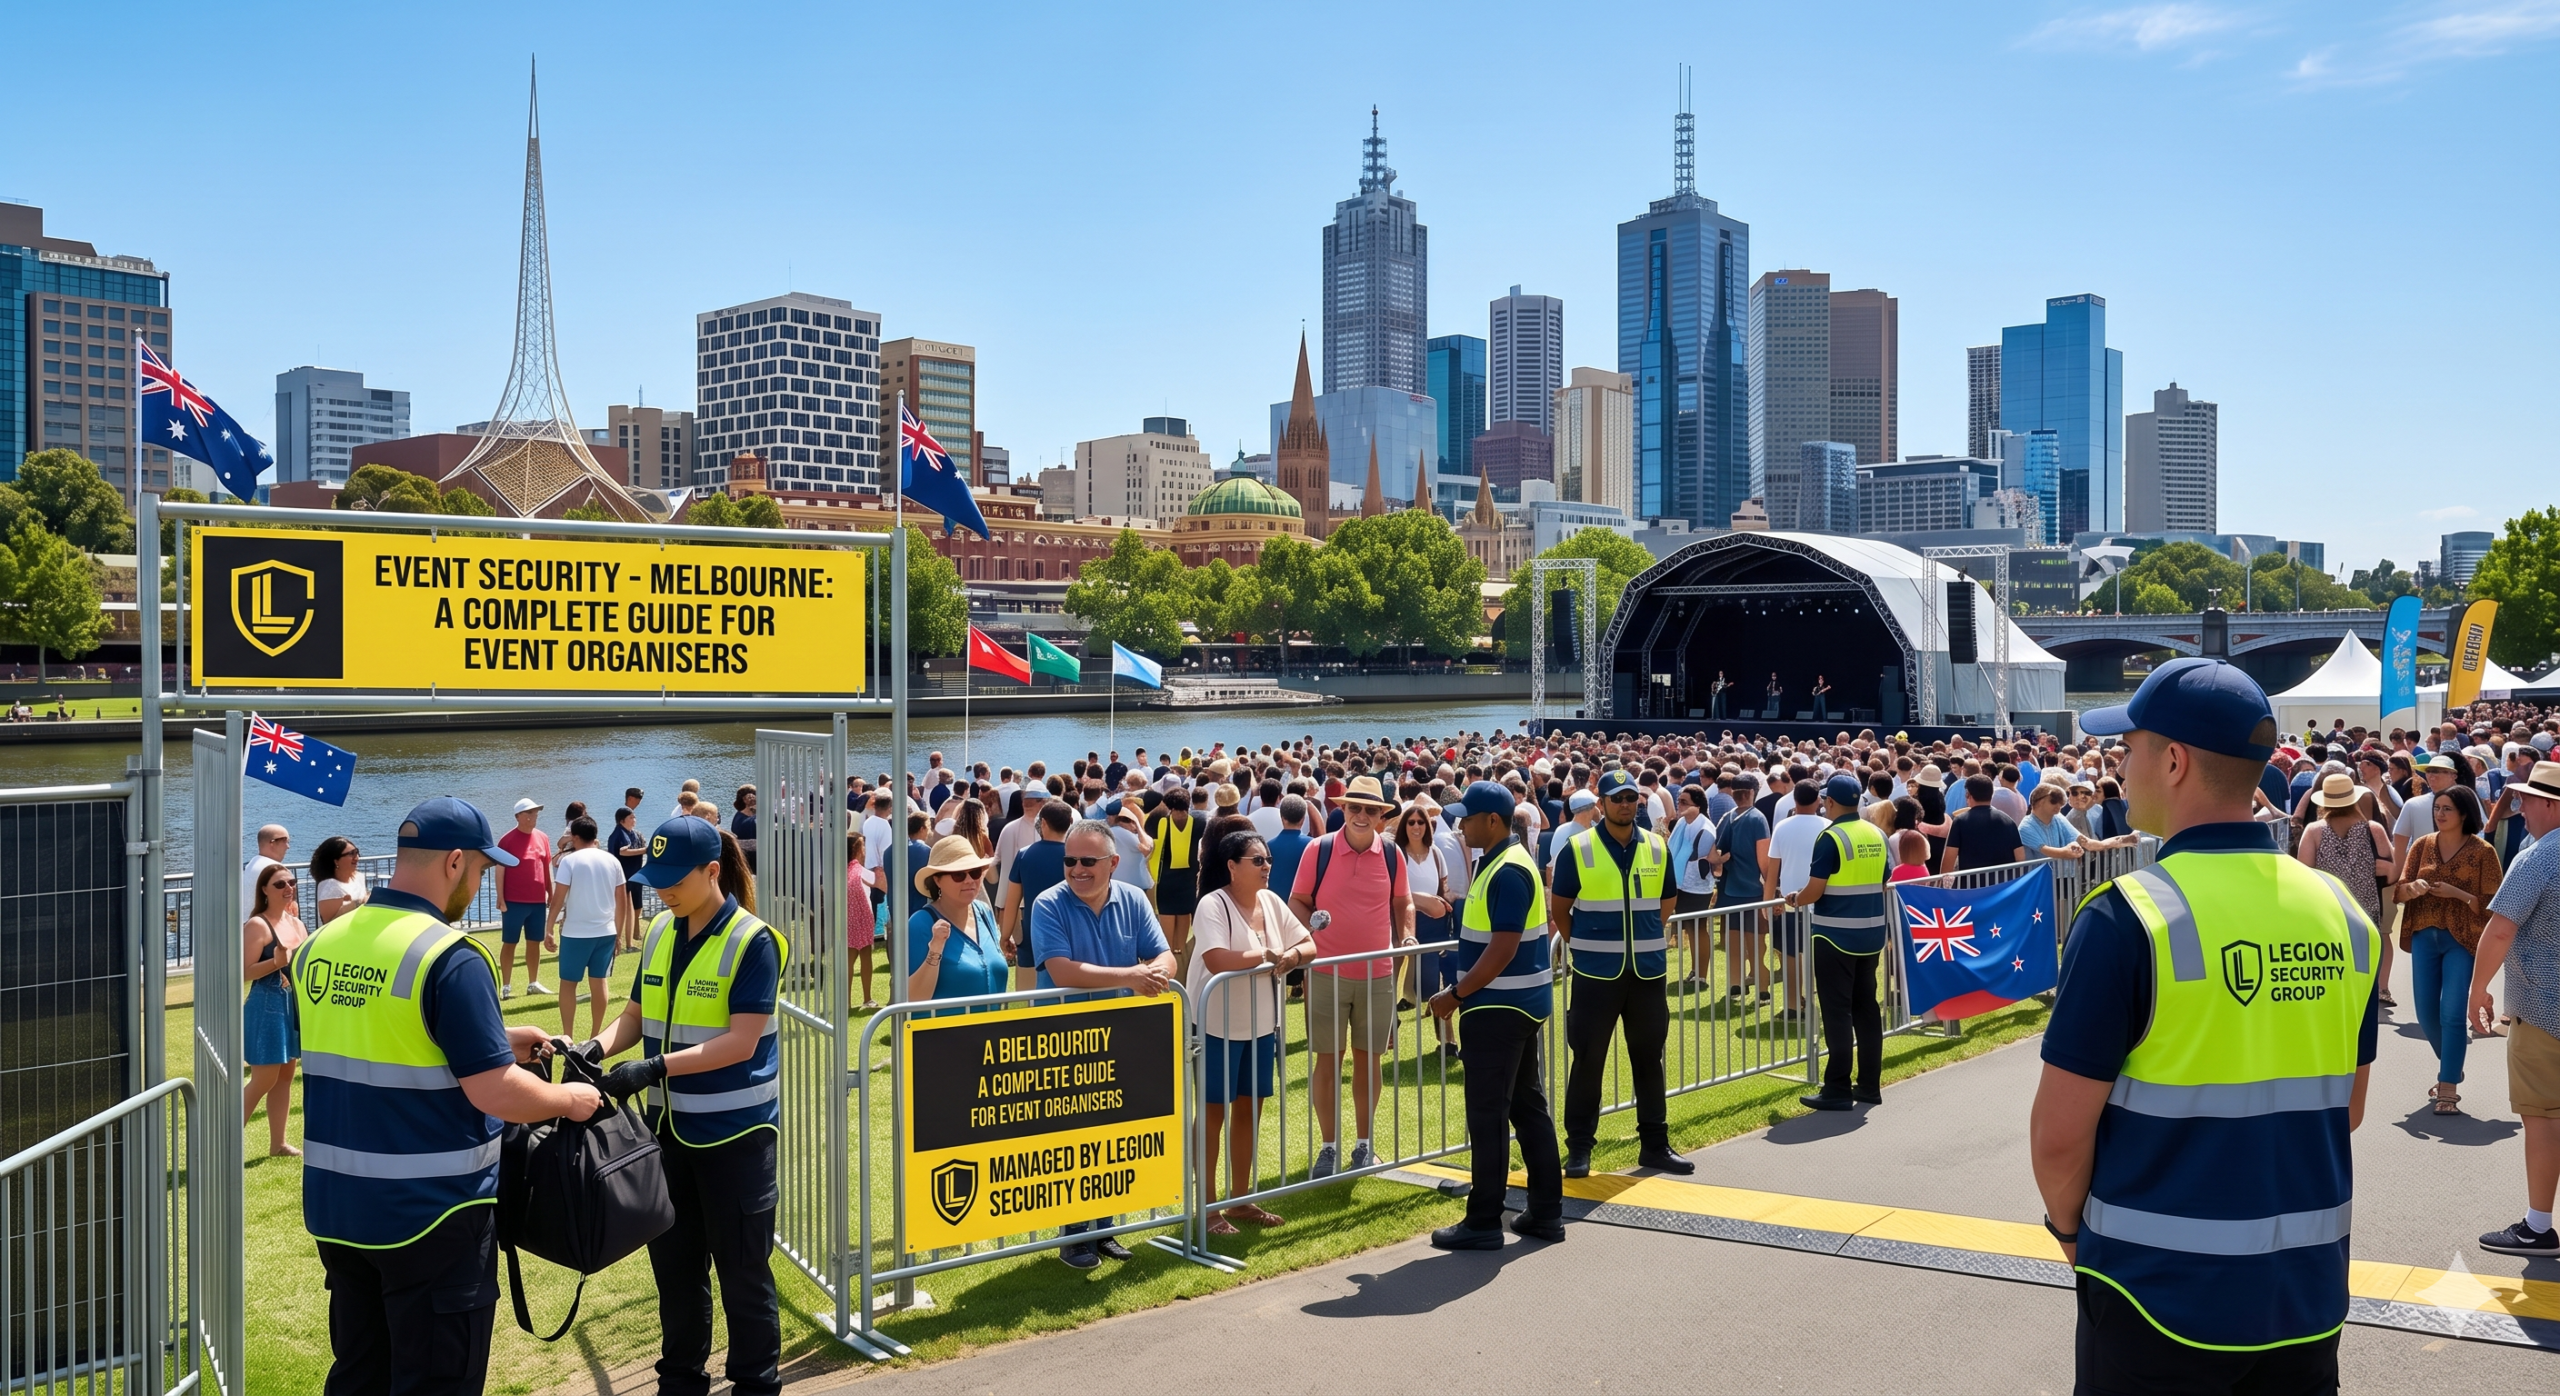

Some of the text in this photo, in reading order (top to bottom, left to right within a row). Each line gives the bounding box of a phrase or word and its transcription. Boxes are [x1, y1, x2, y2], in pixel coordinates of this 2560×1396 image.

[374, 555, 470, 590] EVENT
[478, 558, 621, 593] SECURITY
[650, 563, 834, 599] MELBOURNE:
[434, 597, 776, 636] A COMPLETE GUIDE FOR
[464, 637, 749, 675] EVENT ORGANISERS
[2268, 942, 2345, 963] LEGION
[332, 979, 383, 998] SECURITY
[333, 962, 388, 984] LEGION
[2270, 966, 2345, 982] SECURITY
[331, 993, 366, 1008] GROUP
[2270, 985, 2326, 1002] GROUP
[982, 1039, 995, 1065] A
[977, 1059, 1116, 1099] A COMPLETE GUIDE
[970, 1088, 1123, 1128] FOR EVENT ORGANISERS
[989, 1130, 1165, 1184] MANAGED BY LEGION
[989, 1168, 1136, 1217] SECURITY GROUP
